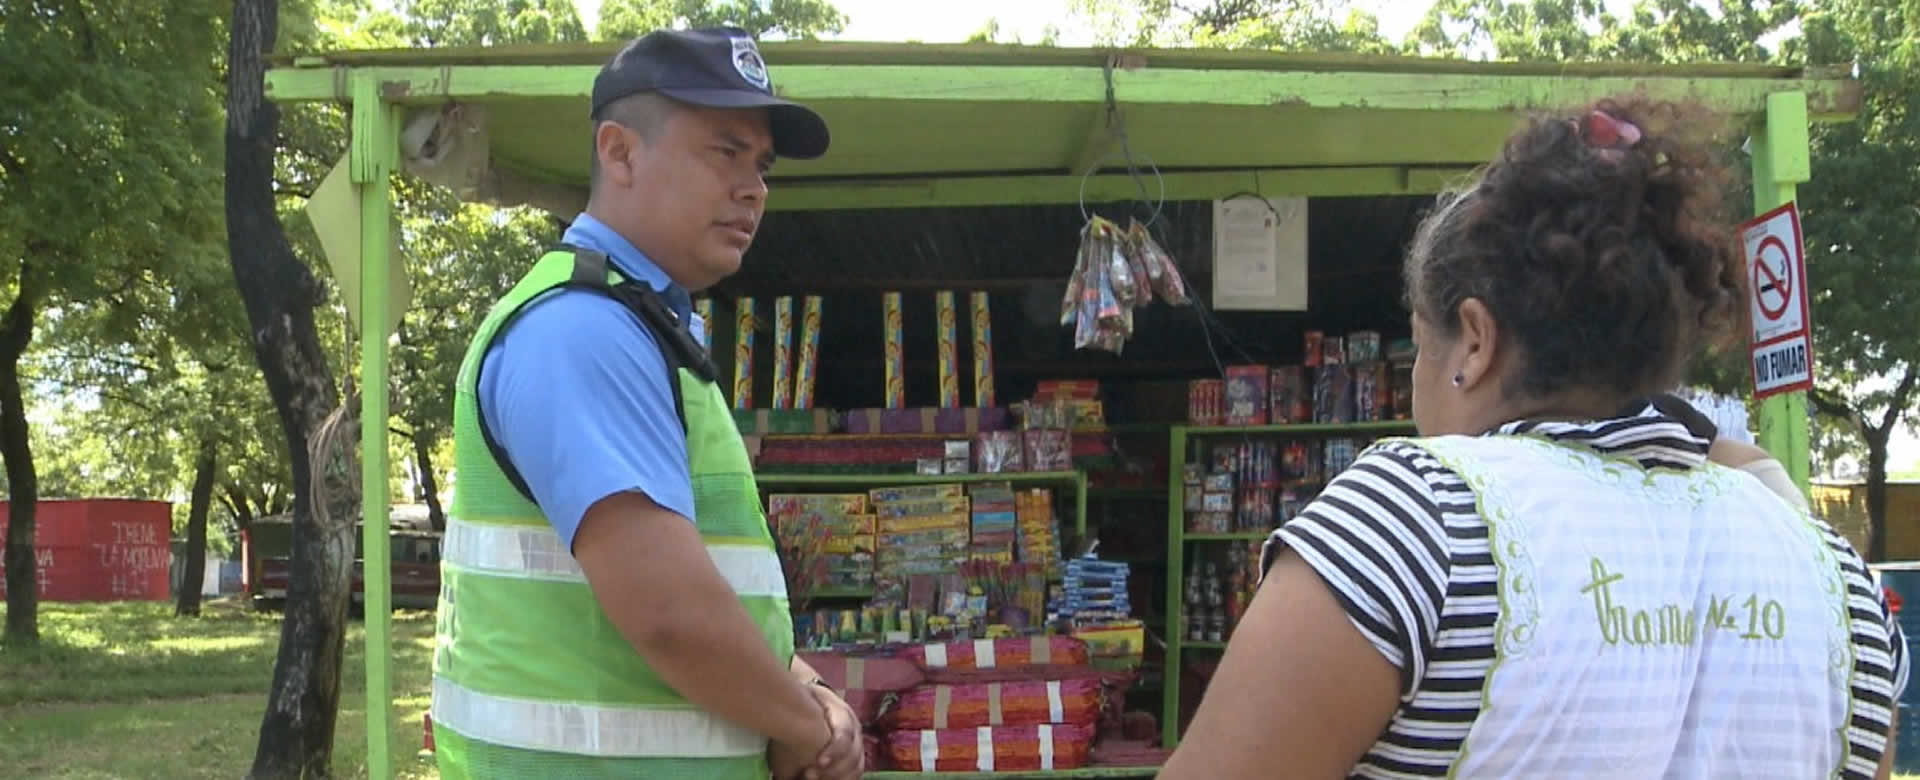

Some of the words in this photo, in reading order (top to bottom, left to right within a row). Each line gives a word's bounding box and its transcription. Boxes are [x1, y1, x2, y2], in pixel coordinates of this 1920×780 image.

[1755, 354, 1768, 382] NO
[1770, 344, 1806, 380] FUMAR
[1738, 592, 1785, 640] 10
